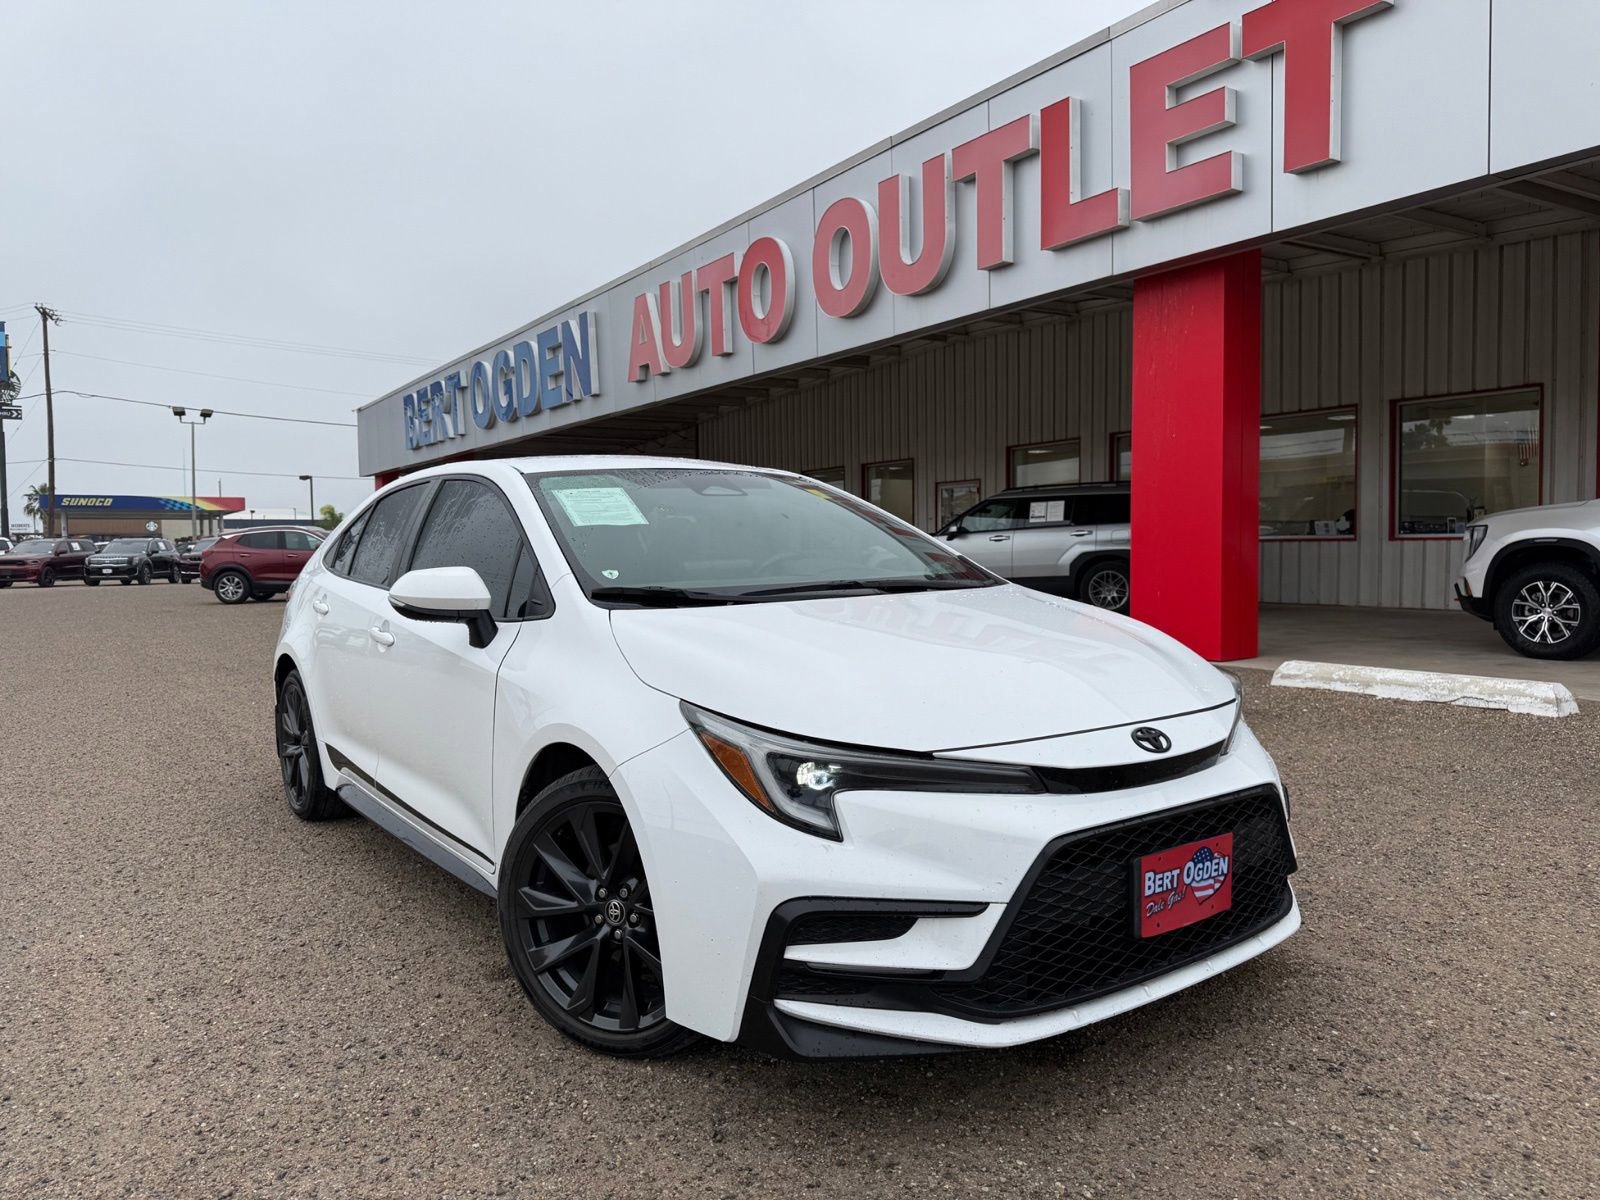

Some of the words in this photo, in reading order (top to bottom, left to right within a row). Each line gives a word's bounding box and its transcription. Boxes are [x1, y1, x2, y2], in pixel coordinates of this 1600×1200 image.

[403, 370, 468, 449] BERT
[470, 311, 600, 430] OGDEN
[628, 236, 796, 383] AUTO
[812, 0, 1394, 318] OUTLET
[61, 497, 113, 506] SUNOCO
[1144, 868, 1180, 896] BERT
[1183, 855, 1229, 885] OGDEN
